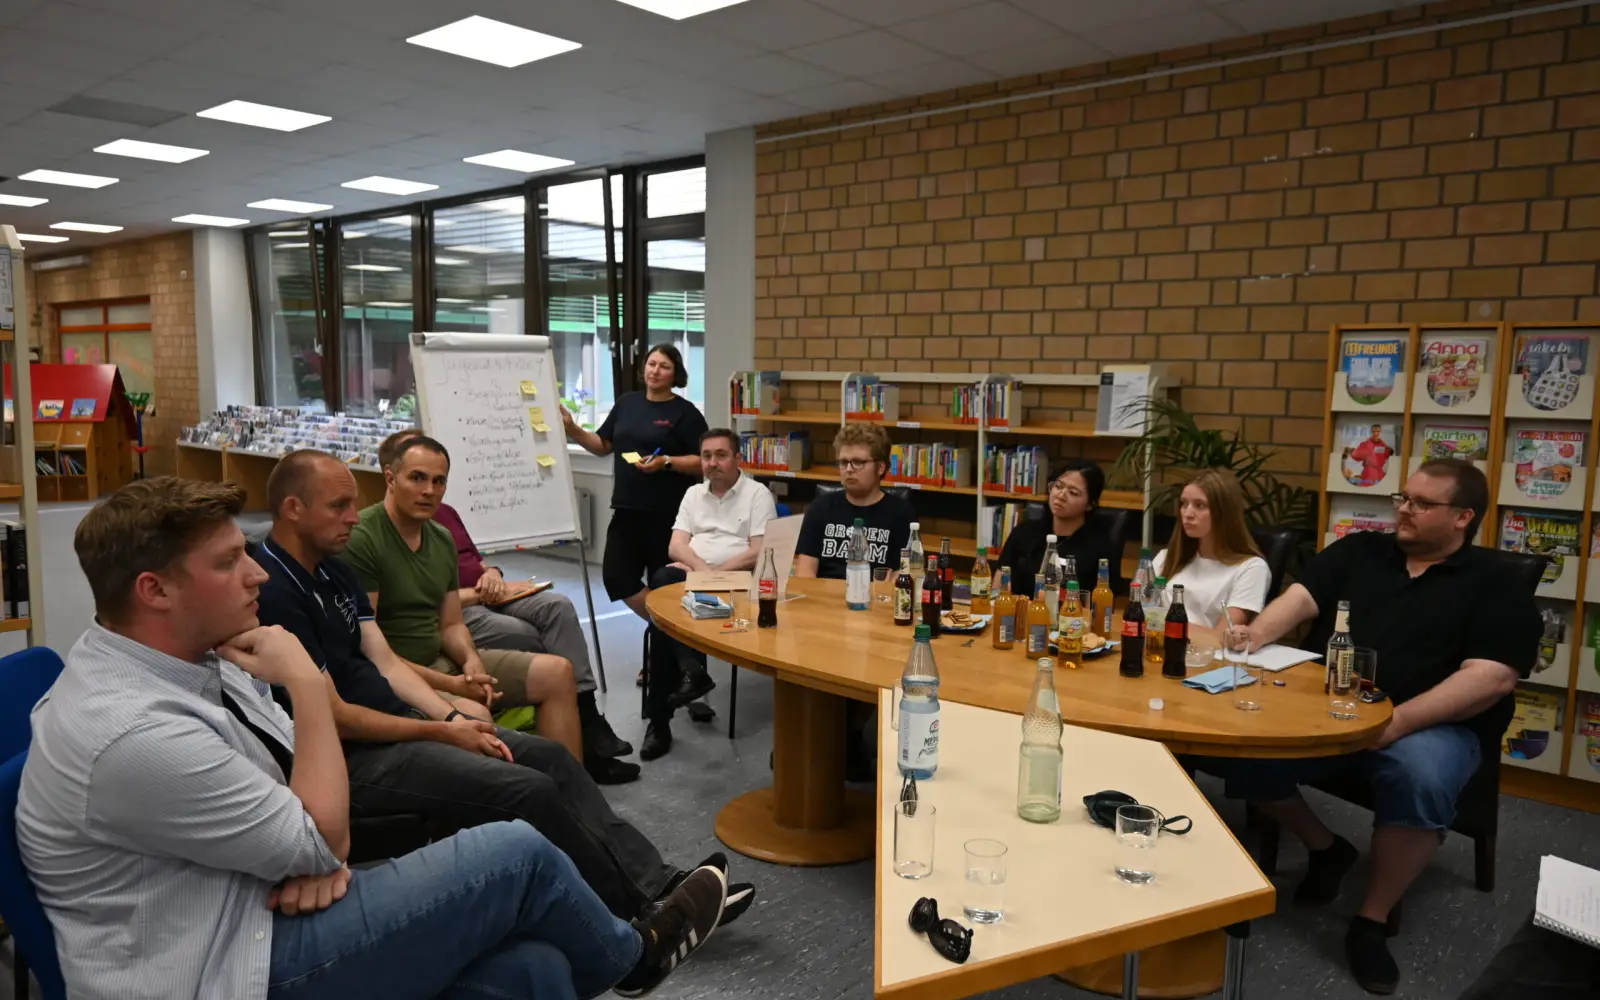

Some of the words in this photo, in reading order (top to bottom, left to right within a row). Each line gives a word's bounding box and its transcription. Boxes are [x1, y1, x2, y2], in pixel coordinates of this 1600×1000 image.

[1427, 341, 1479, 355] Anna
[1432, 429, 1476, 441] garten
[1506, 517, 1525, 527] Lisa
[824, 523, 890, 543] GROEN
[821, 538, 888, 564] BAM
